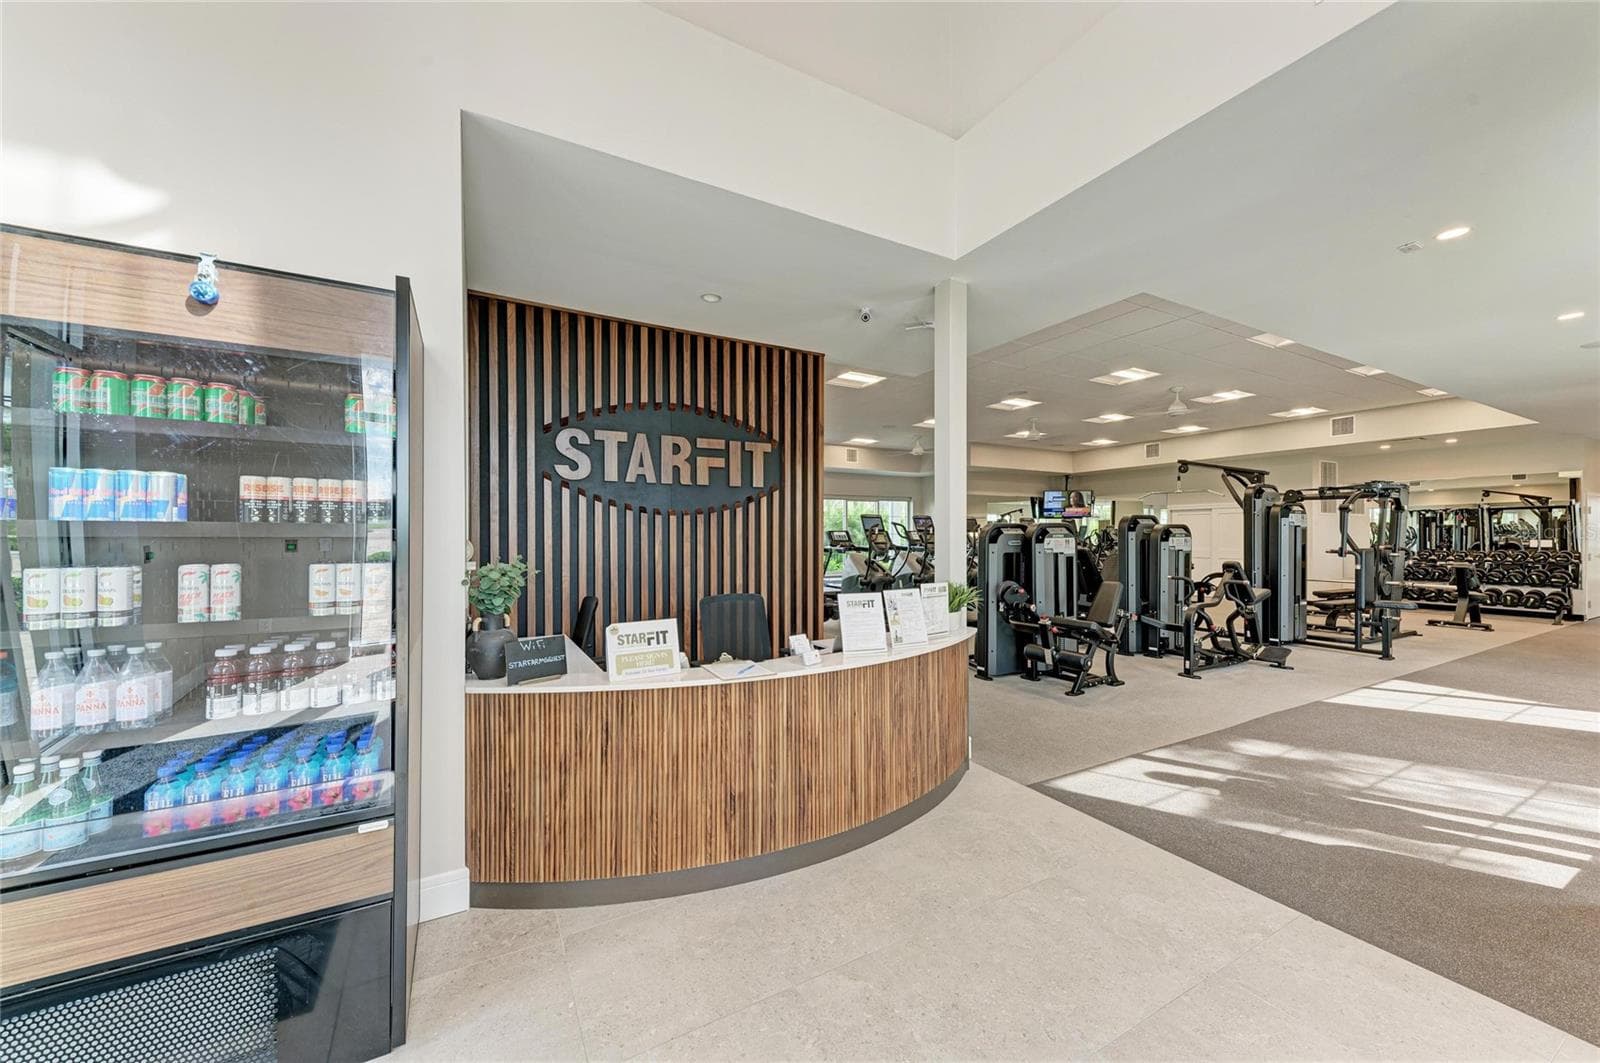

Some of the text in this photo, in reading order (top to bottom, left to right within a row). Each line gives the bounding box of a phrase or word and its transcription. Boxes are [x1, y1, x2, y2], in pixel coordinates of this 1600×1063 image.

[553, 427, 772, 488] STARFIT
[846, 599, 876, 609] STARFIT
[616, 630, 669, 646] STARFIT
